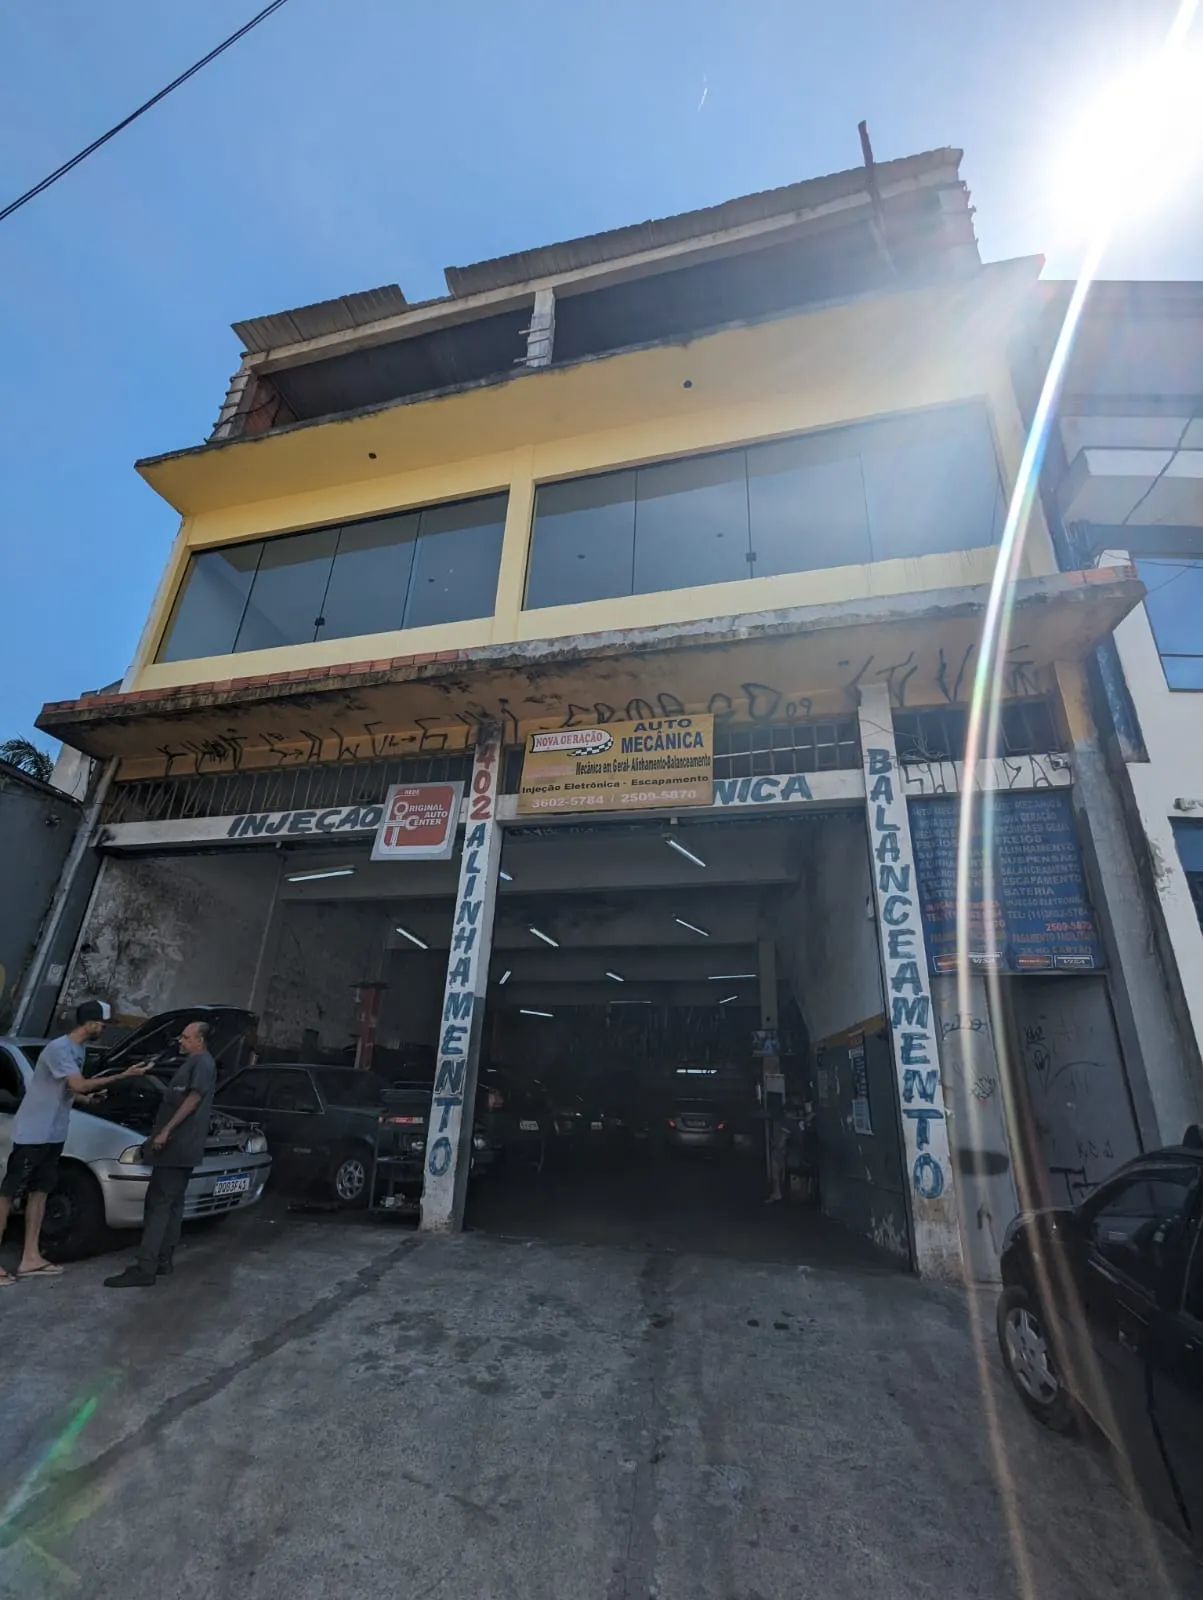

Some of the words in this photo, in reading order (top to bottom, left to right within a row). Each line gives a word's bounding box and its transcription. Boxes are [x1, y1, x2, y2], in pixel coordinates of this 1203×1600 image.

[634, 718, 692, 732] AUTO
[535, 736, 559, 748] NOVA
[621, 730, 704, 753] MECÂNICA
[469, 741, 497, 821] 402
[522, 784, 561, 794] Injeção
[564, 781, 620, 790] Eletrônica
[631, 776, 709, 786] Escapamento
[531, 796, 604, 808] 3602-5784
[621, 790, 697, 803] 2509-5870
[1002, 874, 1082, 886] ESCAPAMENTO
[1003, 886, 1055, 896] BATERIA
[867, 748, 944, 1199] BALANCEAMENTO
[427, 822, 487, 1178] ALINHAMENTO
